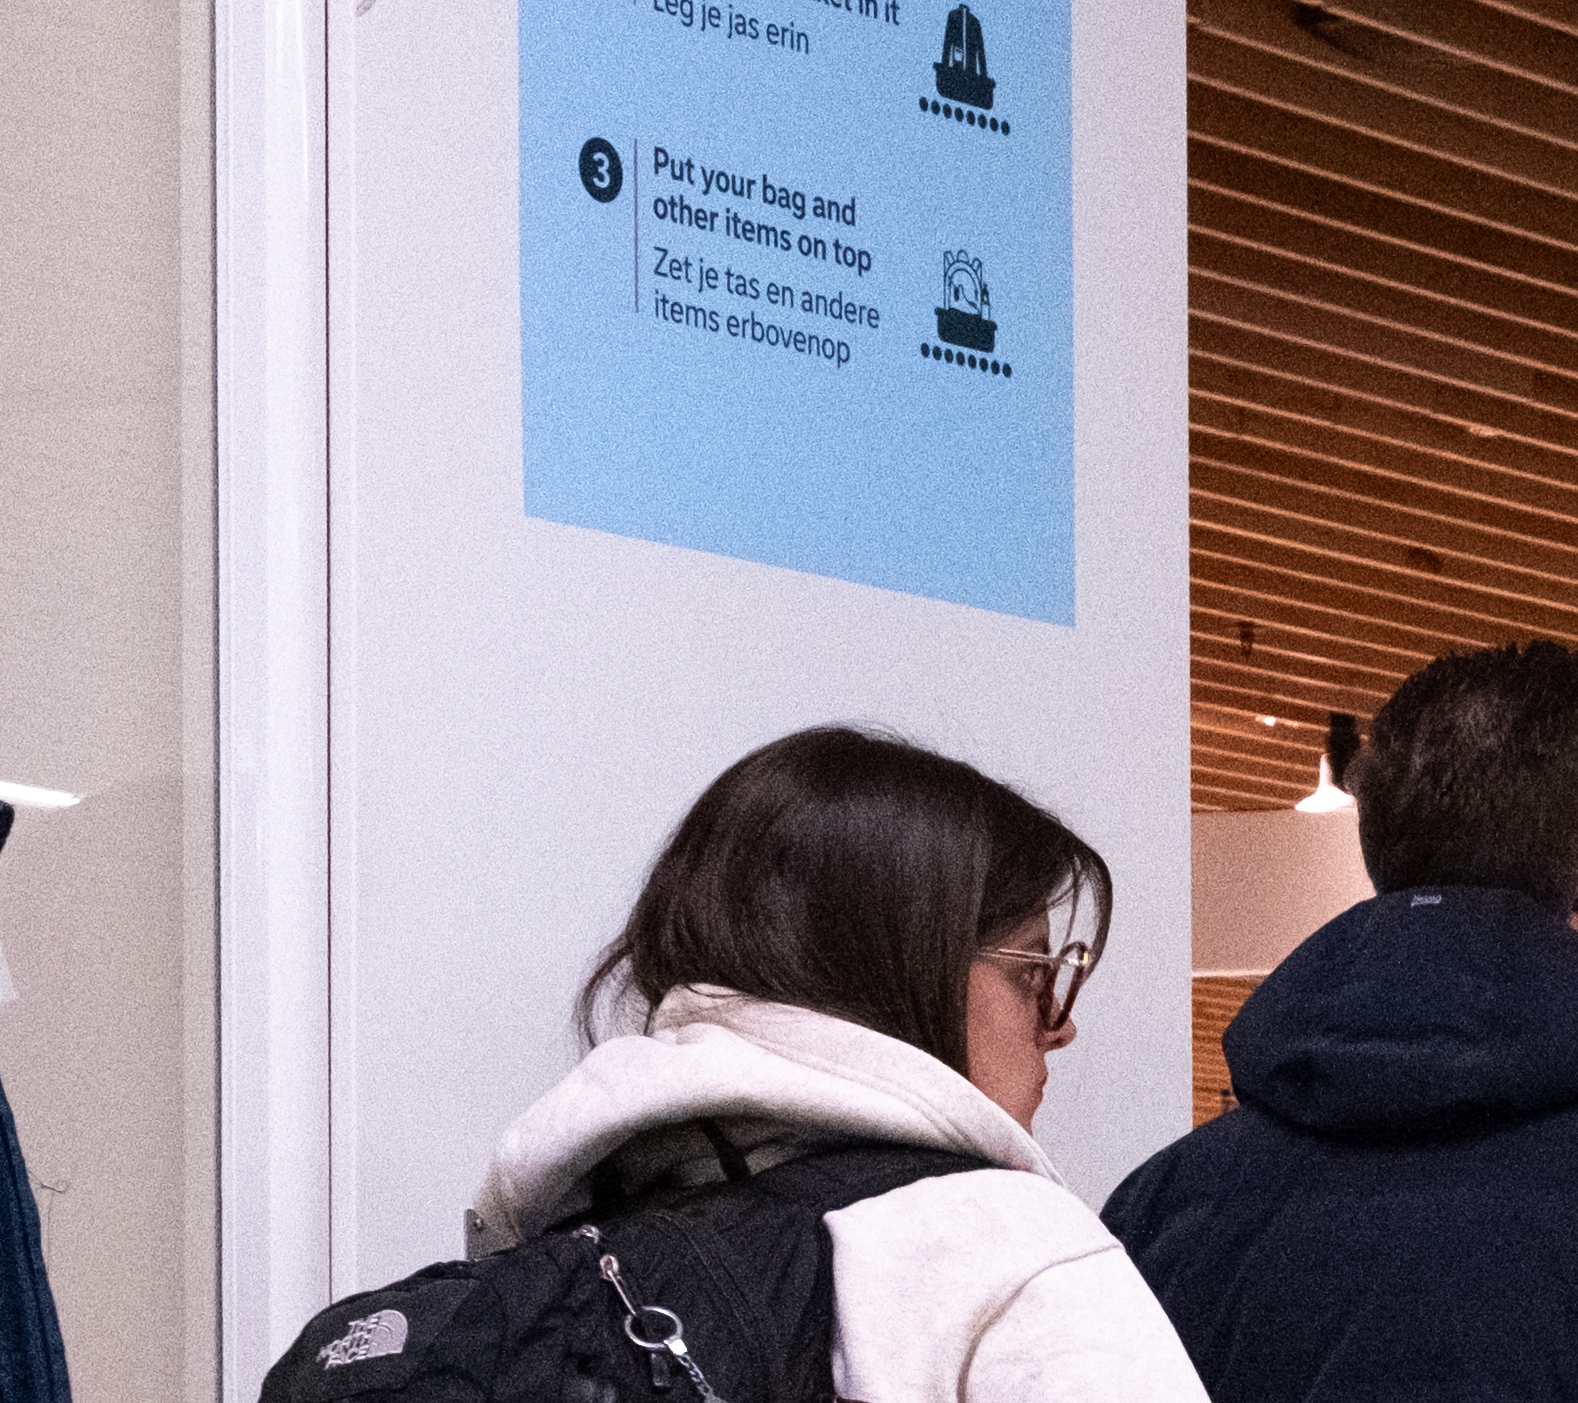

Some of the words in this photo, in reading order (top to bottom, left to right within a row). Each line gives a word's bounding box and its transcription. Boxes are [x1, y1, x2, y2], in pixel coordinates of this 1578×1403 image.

[701, 4, 721, 32] je
[727, 4, 760, 40] jas
[766, 21, 810, 54] erin
[654, 146, 694, 186] Put
[700, 166, 756, 200] your
[762, 174, 806, 220] bag
[812, 197, 856, 227] and
[653, 194, 719, 232] other
[725, 208, 792, 251] items
[798, 234, 827, 261] on
[833, 239, 872, 277] top
[653, 246, 693, 284] Zet
[698, 257, 719, 293] je
[725, 267, 760, 300] tas
[767, 281, 794, 309] en
[801, 291, 880, 329] andere
[653, 289, 720, 333] items
[726, 311, 851, 368] erbovenop
